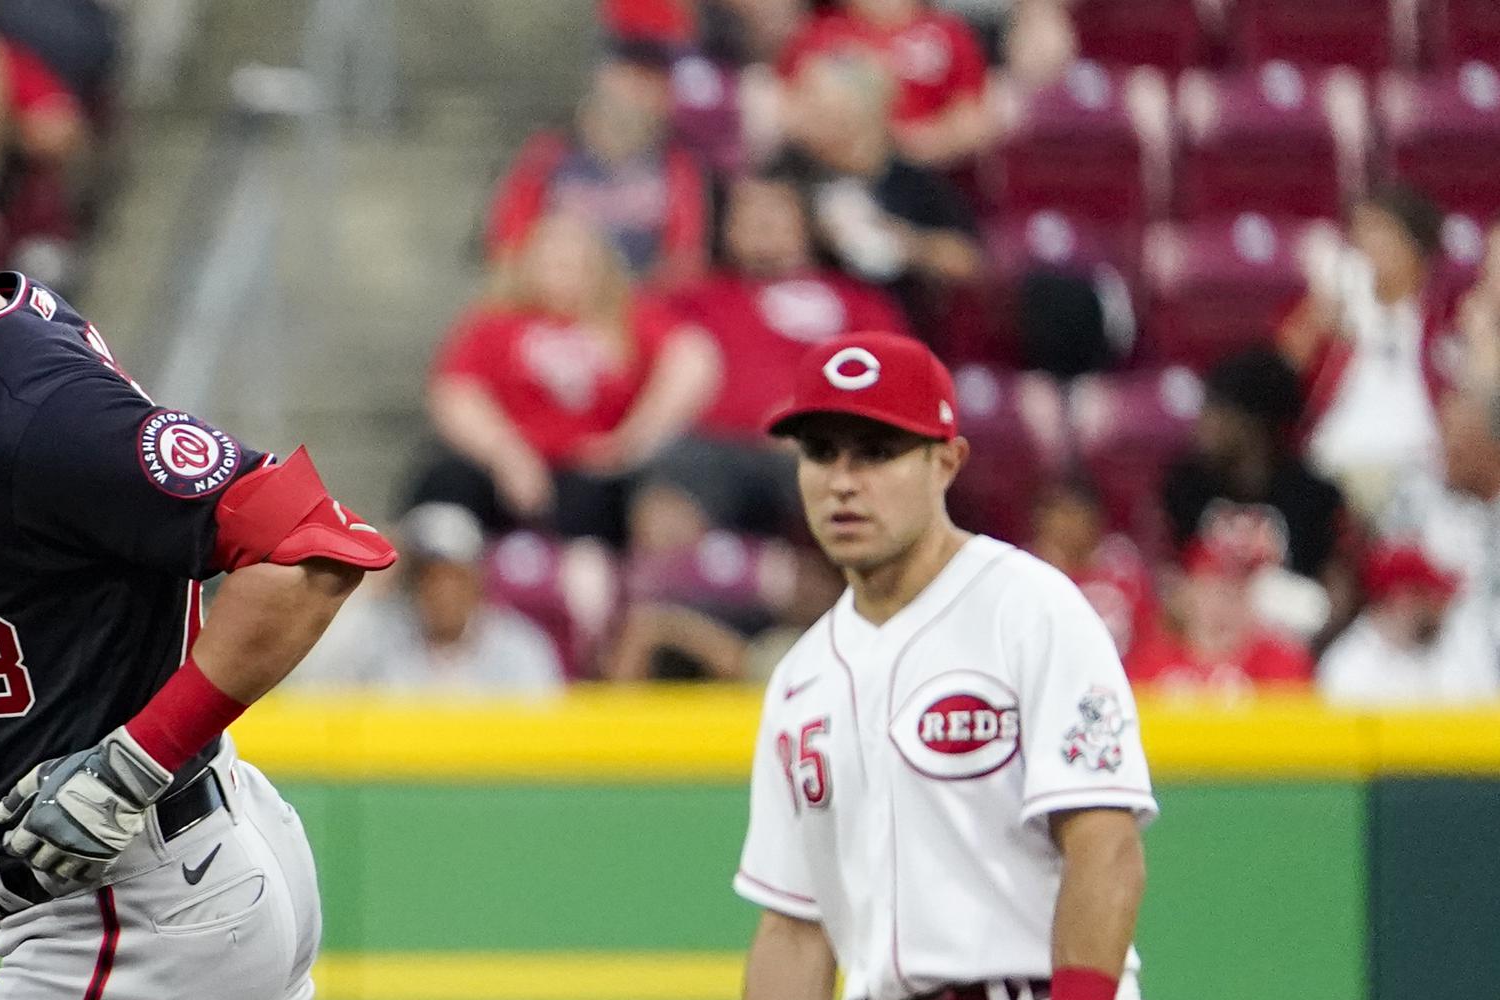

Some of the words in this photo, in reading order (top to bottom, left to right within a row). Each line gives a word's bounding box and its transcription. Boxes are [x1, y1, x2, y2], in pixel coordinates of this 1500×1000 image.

[141, 412, 190, 485] WASHINGTON
[194, 430, 238, 493] NATIONALS
[920, 708, 1020, 742] REDS
